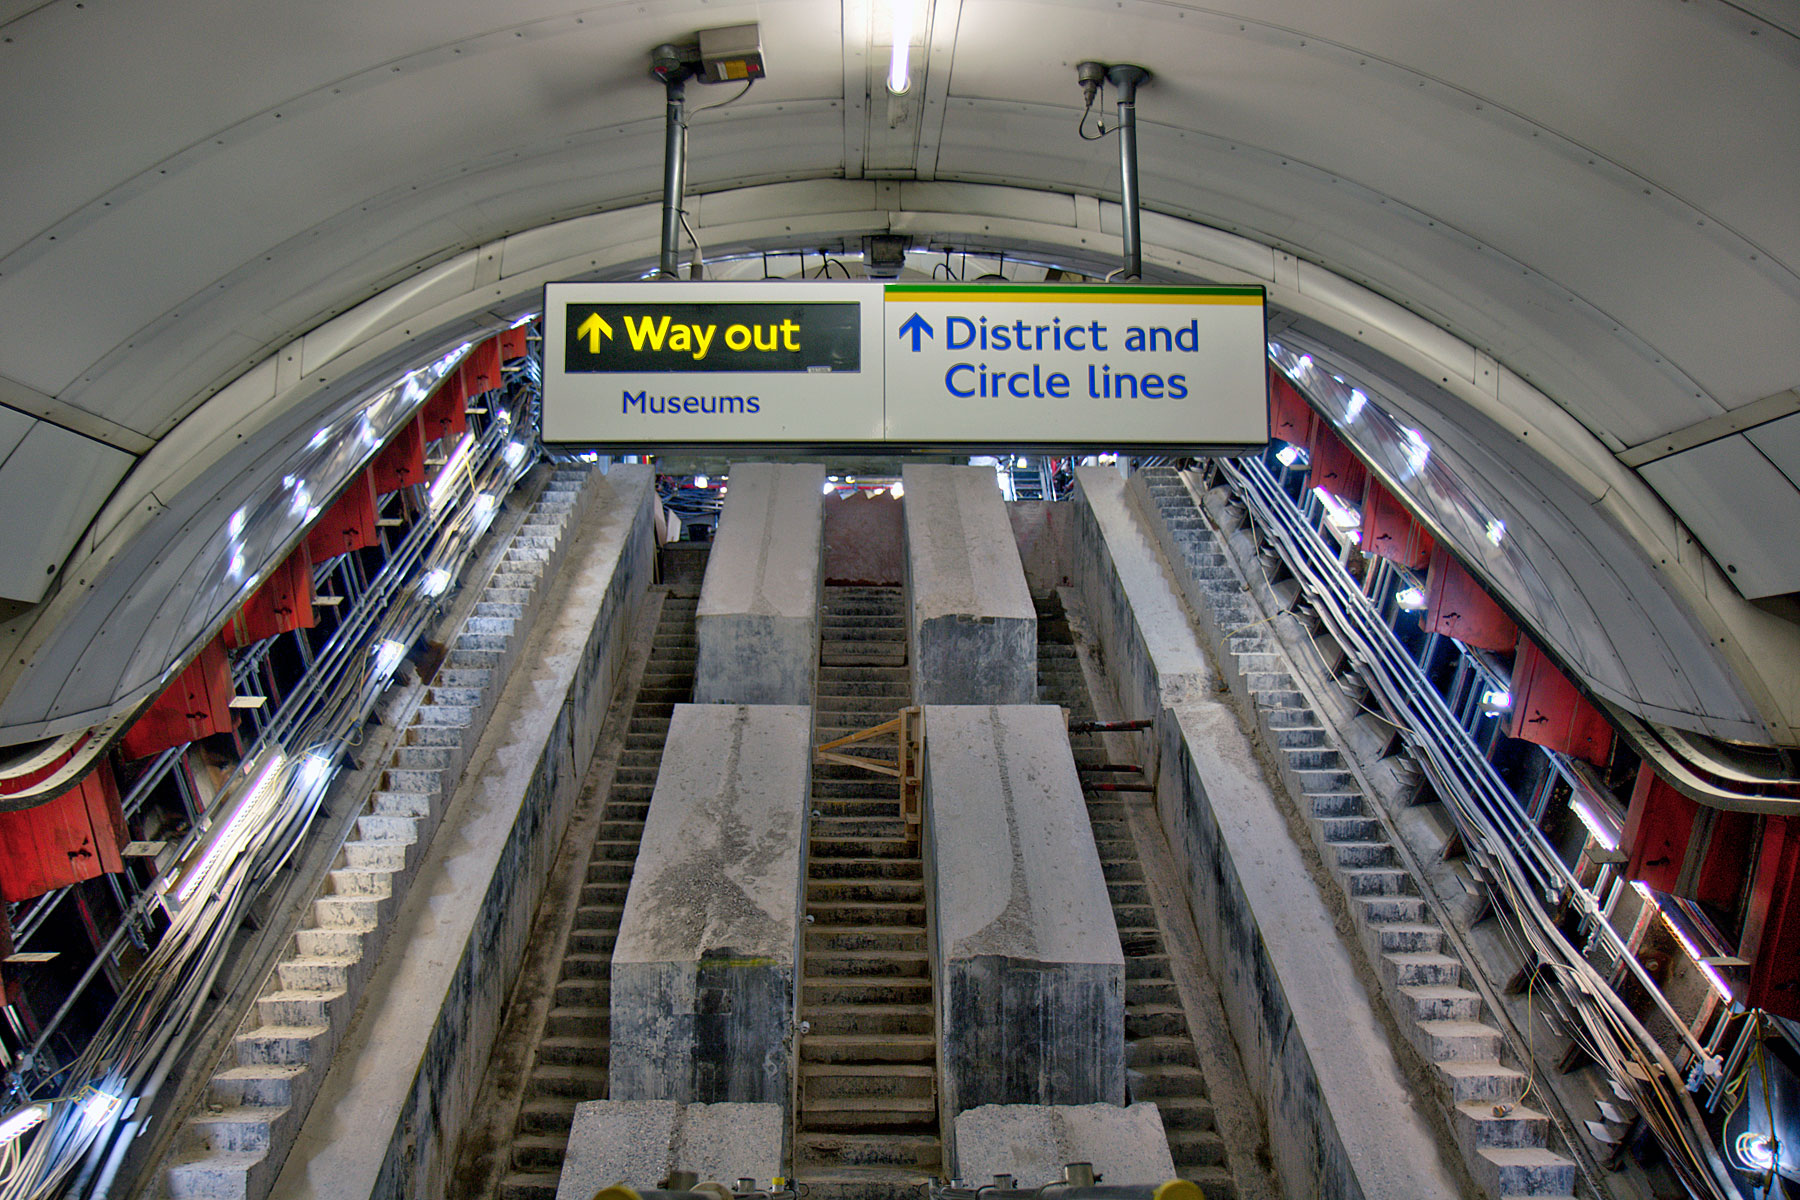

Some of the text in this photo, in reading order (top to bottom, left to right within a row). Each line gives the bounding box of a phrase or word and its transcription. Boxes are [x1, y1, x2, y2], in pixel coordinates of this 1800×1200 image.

[623, 315, 801, 361] Way out
[946, 317, 1199, 352] District and
[945, 363, 1189, 399] Circle lines
[623, 391, 761, 414] Museums
